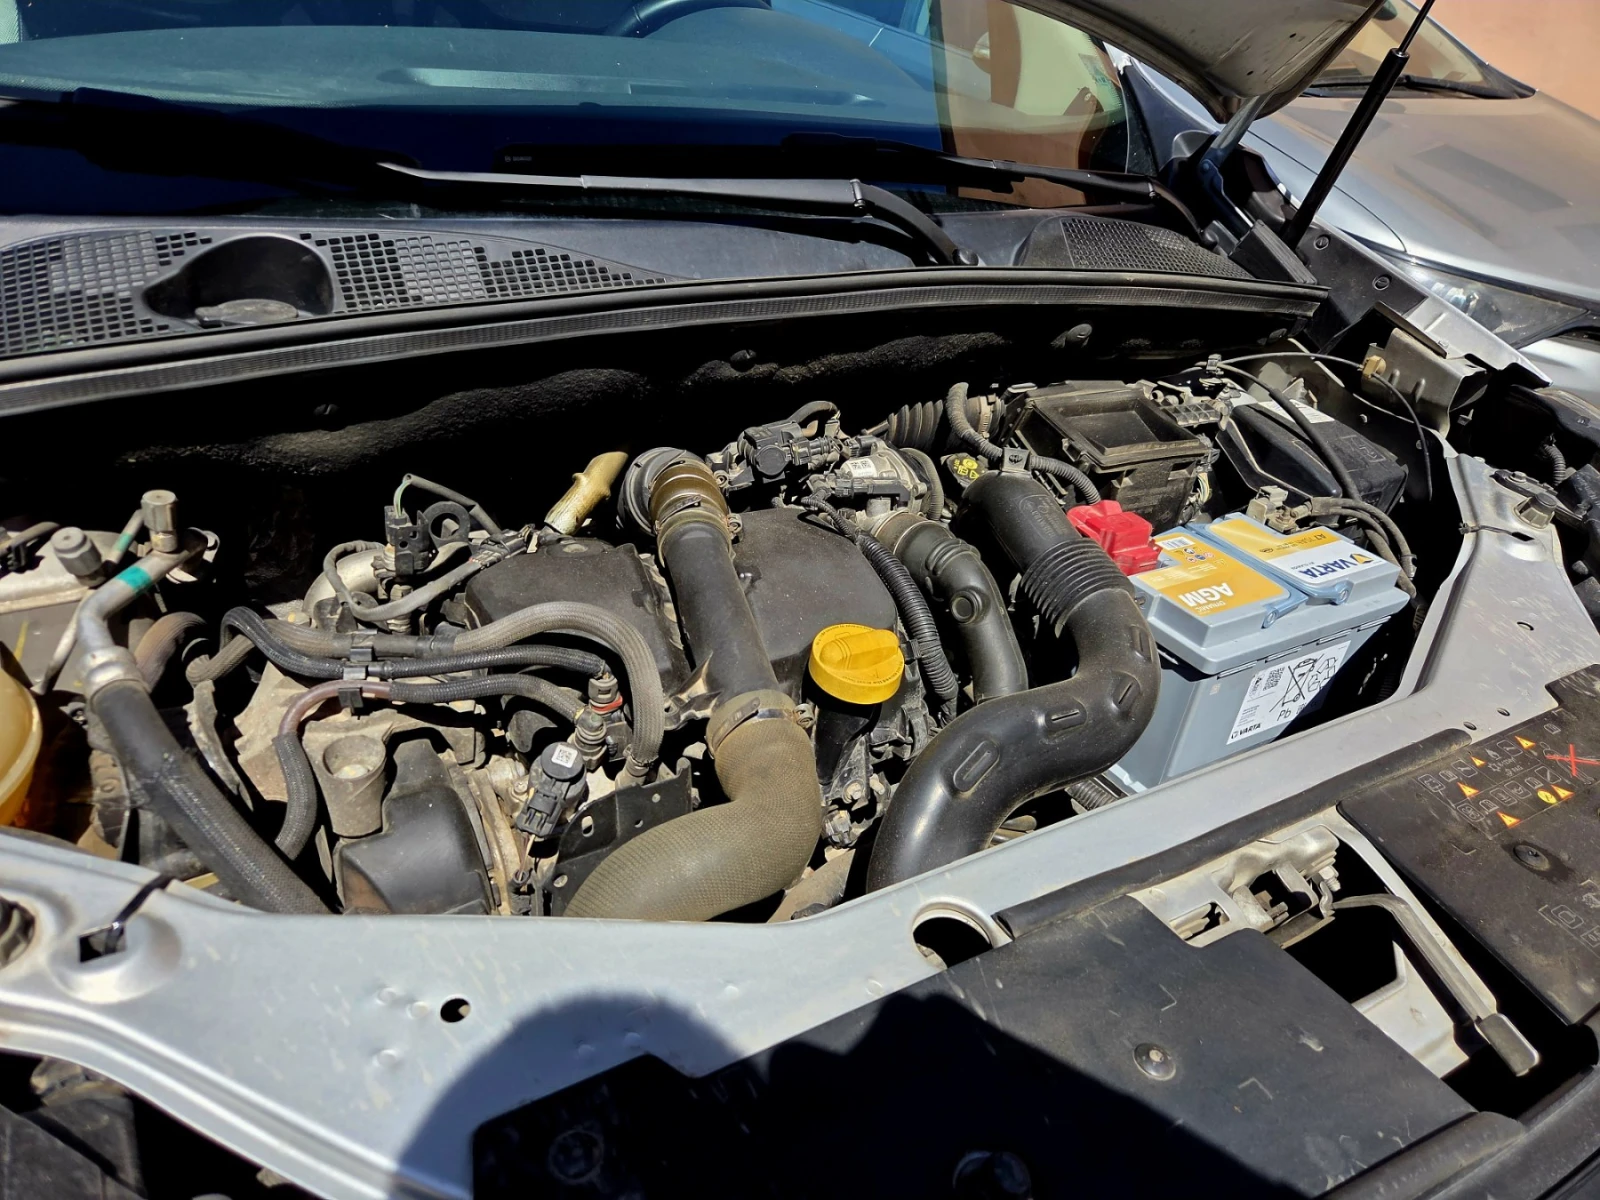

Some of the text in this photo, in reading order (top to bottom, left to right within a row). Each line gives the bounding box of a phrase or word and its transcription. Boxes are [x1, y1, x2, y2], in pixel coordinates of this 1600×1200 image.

[1298, 558, 1358, 578] VARTA
[1178, 582, 1234, 607] AGM
[1195, 600, 1226, 612] DYNAMIC
[1277, 708, 1291, 721] Pb
[1240, 723, 1261, 735] VARTA
